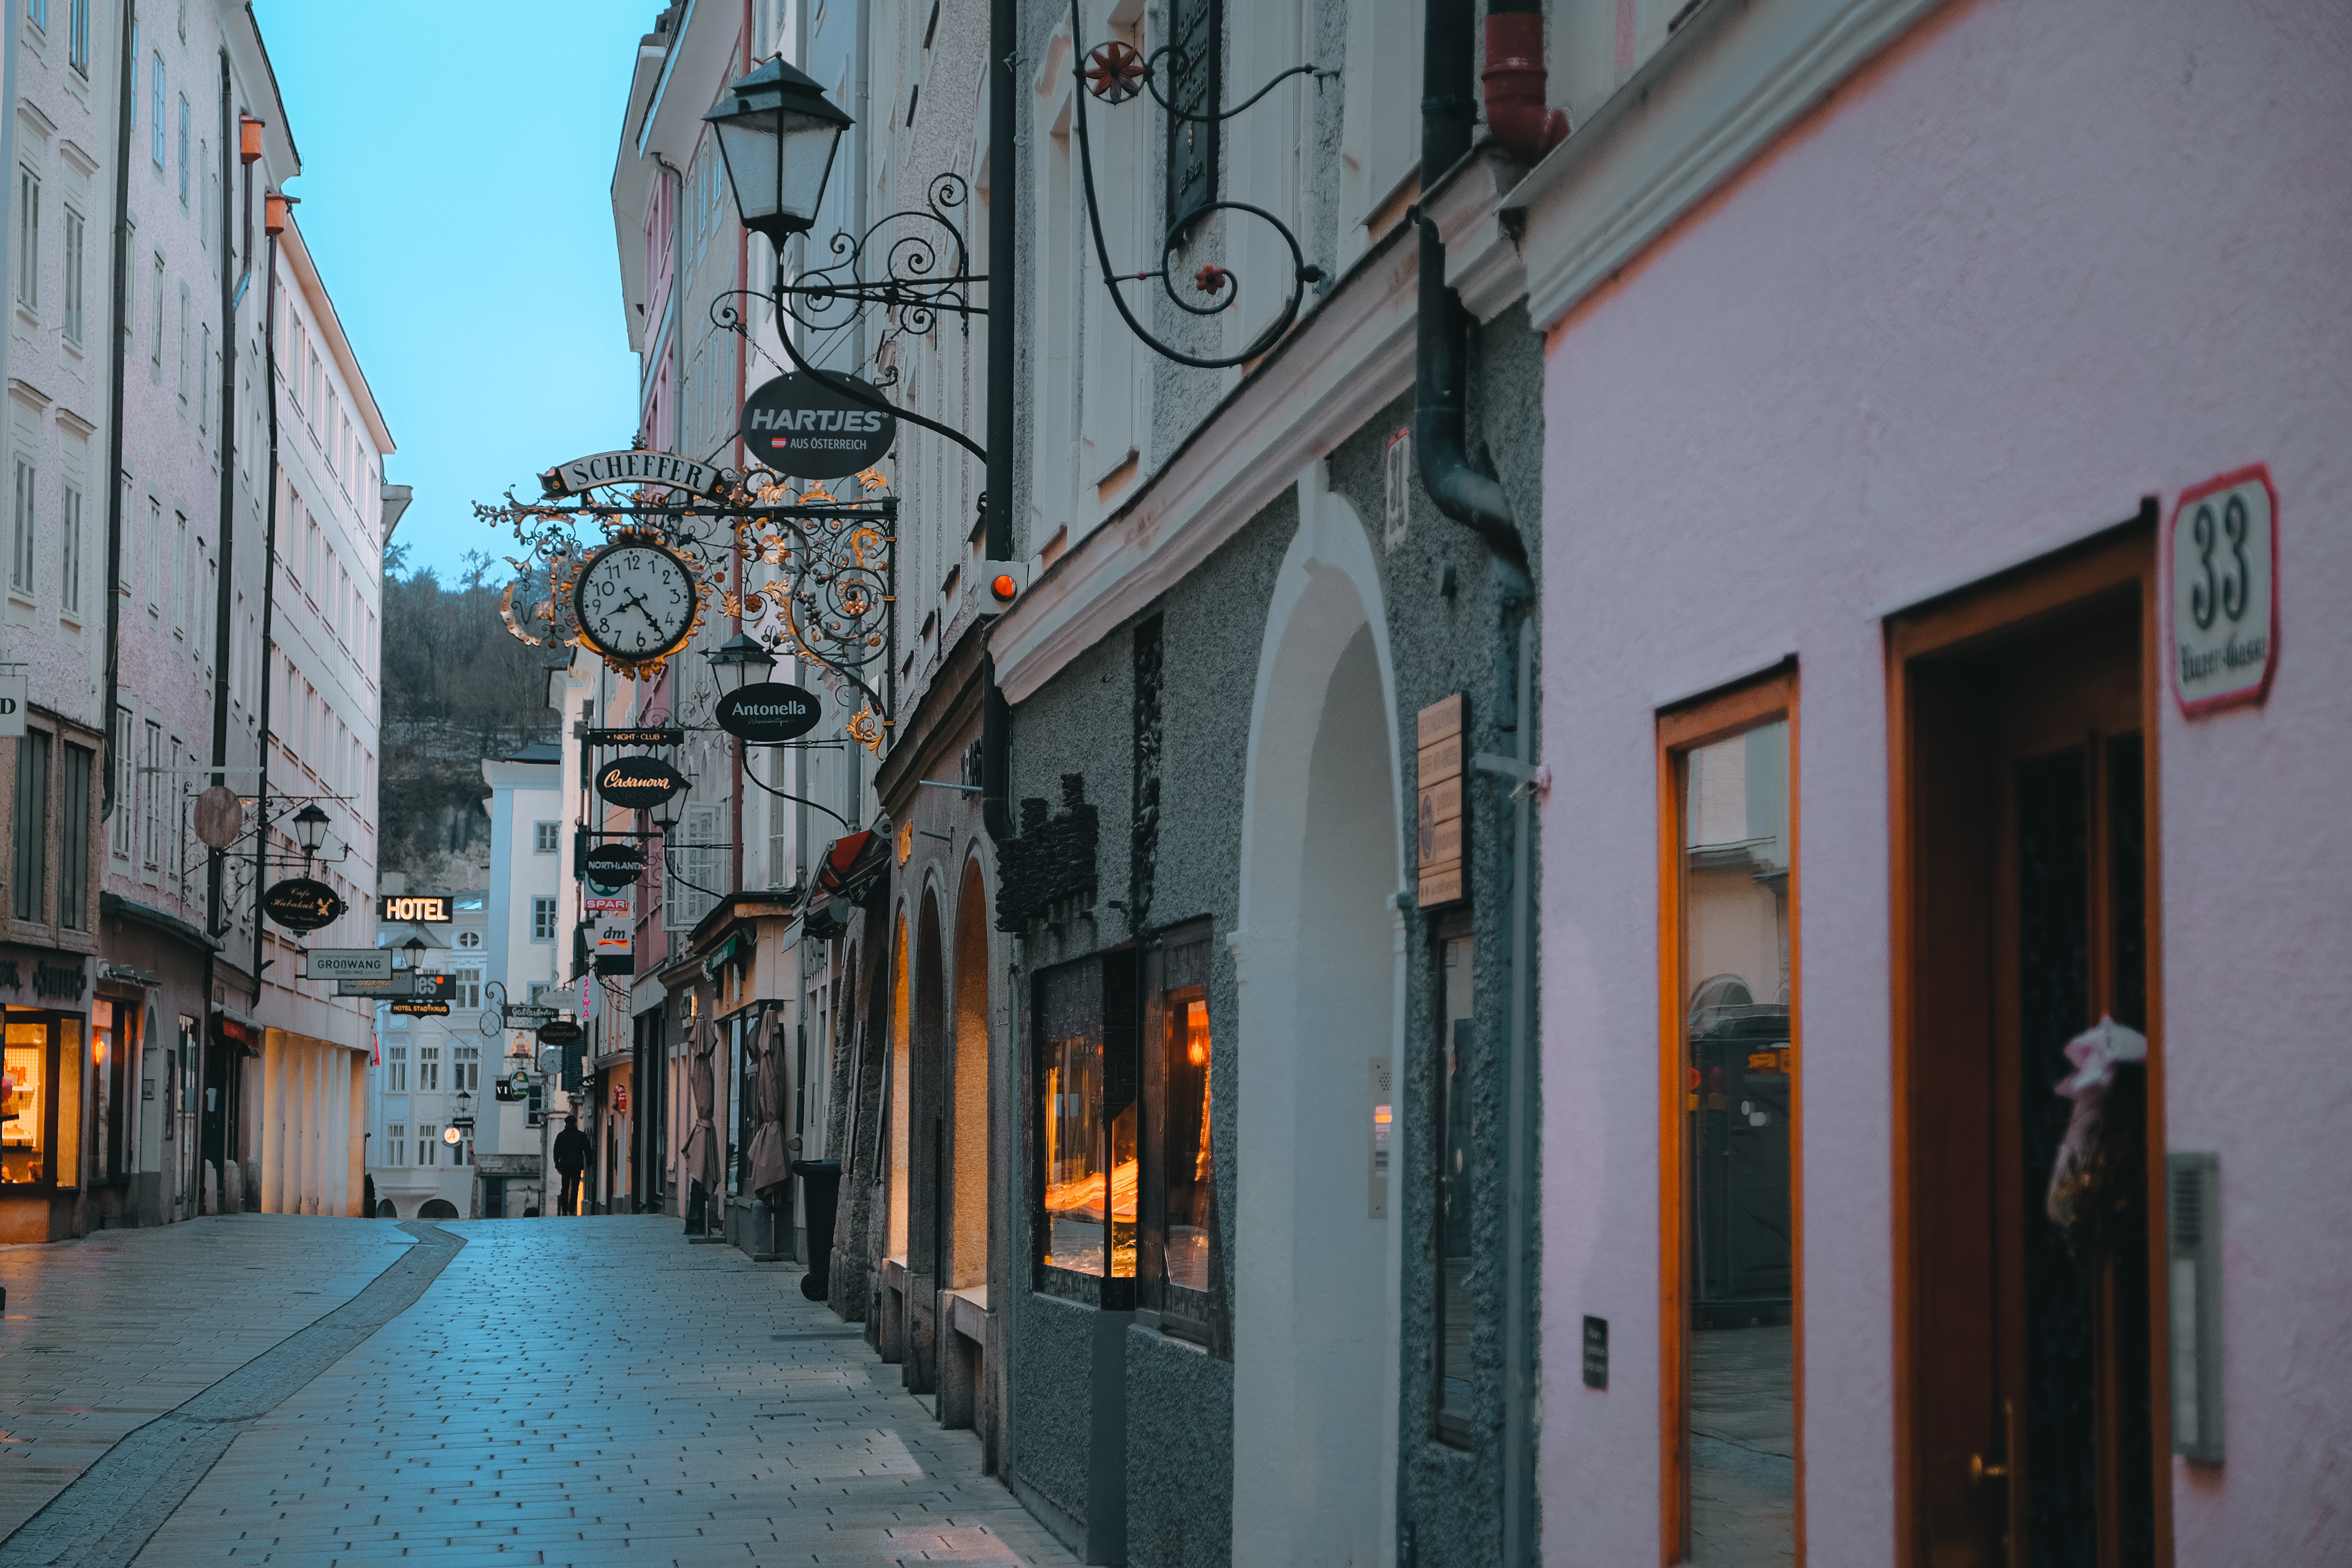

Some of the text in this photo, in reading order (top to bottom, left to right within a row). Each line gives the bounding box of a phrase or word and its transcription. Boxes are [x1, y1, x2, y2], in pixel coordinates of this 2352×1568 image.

[790, 437, 867, 450] AUS ÖSTERREICH
[572, 455, 703, 489] SCHEFFER
[624, 555, 639, 570] 12
[648, 560, 655, 574] 1
[2192, 494, 2249, 631] 33
[605, 564, 620, 579] 11
[662, 570, 670, 585] 2
[592, 581, 615, 596] 10
[670, 589, 680, 604] 3
[592, 599, 601, 615] 9
[599, 617, 609, 633] 8
[665, 612, 674, 626] 4
[614, 630, 622, 646] 7
[636, 631, 646, 647] 6
[732, 700, 806, 716] Antonella
[604, 769, 670, 789] Casanova
[588, 861, 641, 870] NORTHLAND
[386, 897, 450, 921] HOTEL
[603, 927, 625, 939] dm
[317, 960, 381, 969] GROßWANG
[582, 978, 591, 1018] SEWA
